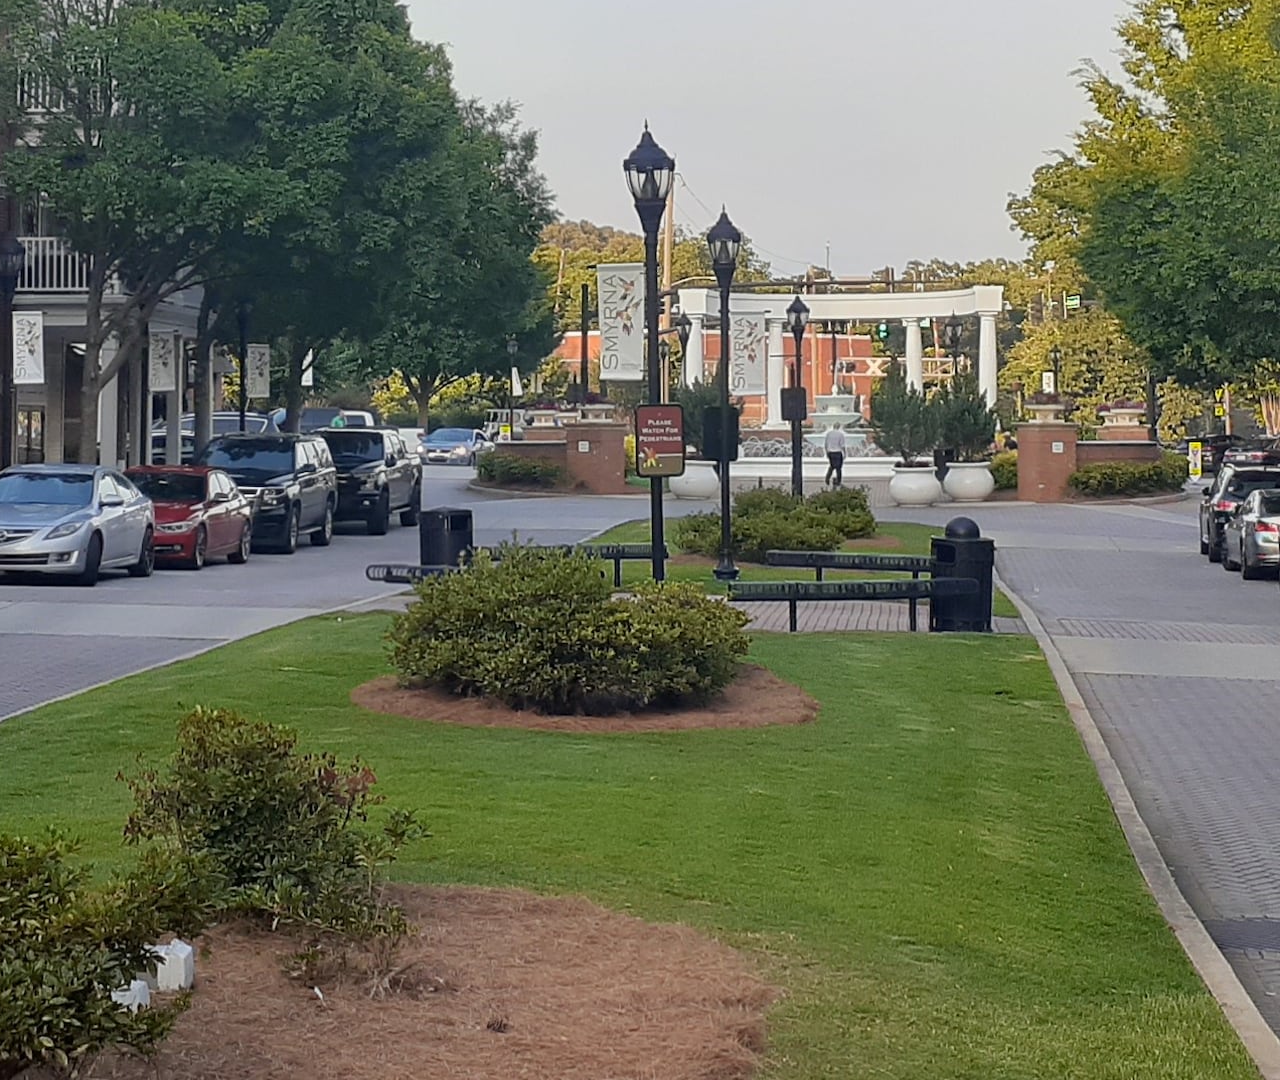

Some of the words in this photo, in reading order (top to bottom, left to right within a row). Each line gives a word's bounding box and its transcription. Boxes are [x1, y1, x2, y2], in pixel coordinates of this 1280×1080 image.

[14, 319, 27, 378] SMYRNA
[602, 274, 619, 370] SMYRNA
[732, 317, 746, 389] SMYRNA
